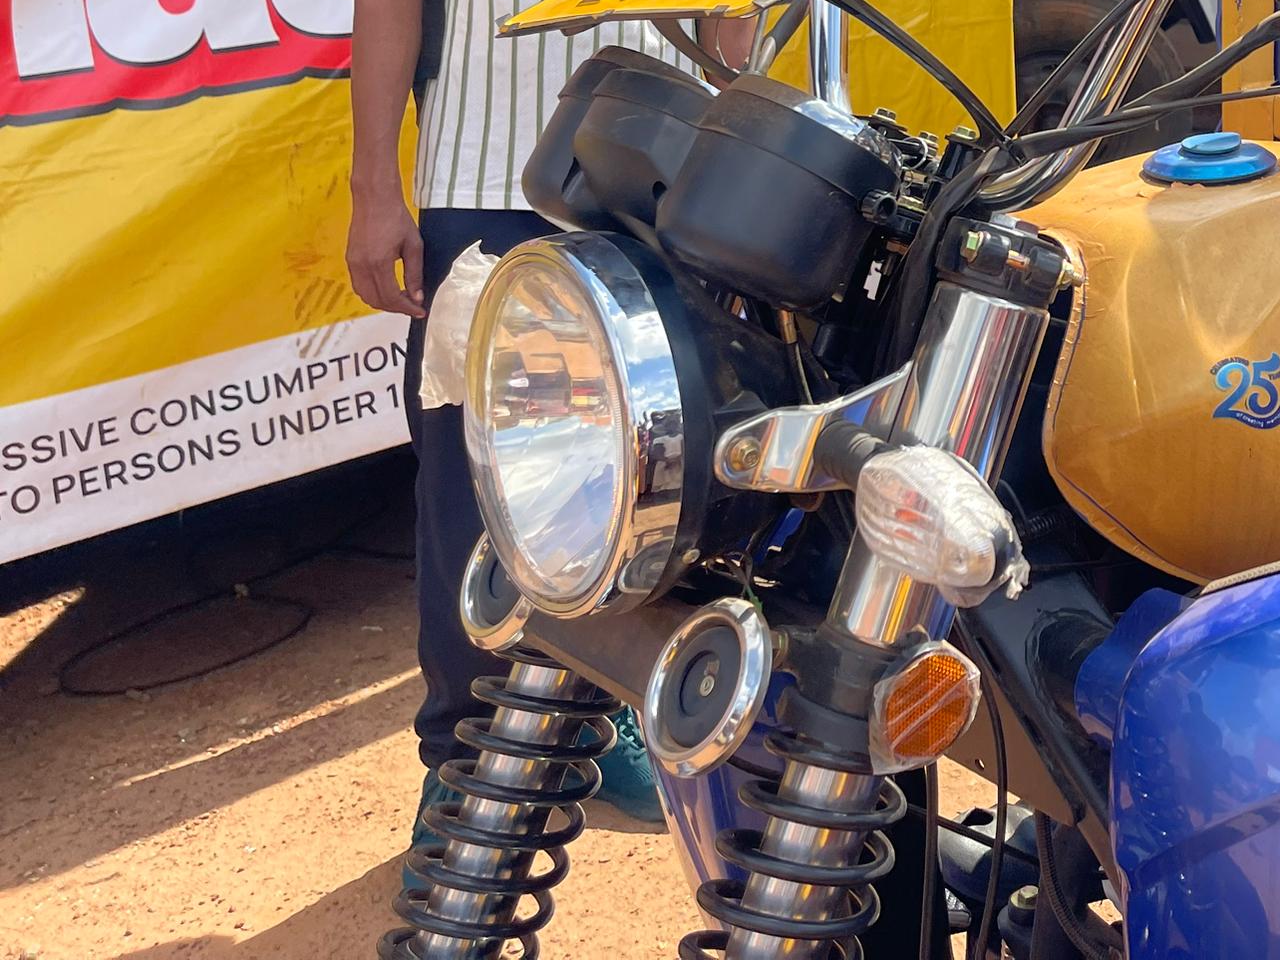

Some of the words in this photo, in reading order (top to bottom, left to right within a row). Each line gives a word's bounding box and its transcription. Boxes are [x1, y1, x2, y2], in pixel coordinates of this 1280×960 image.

[130, 338, 410, 436] CONSUMPTION
[52, 428, 241, 505] PERSONS
[251, 390, 378, 446] UNDER
